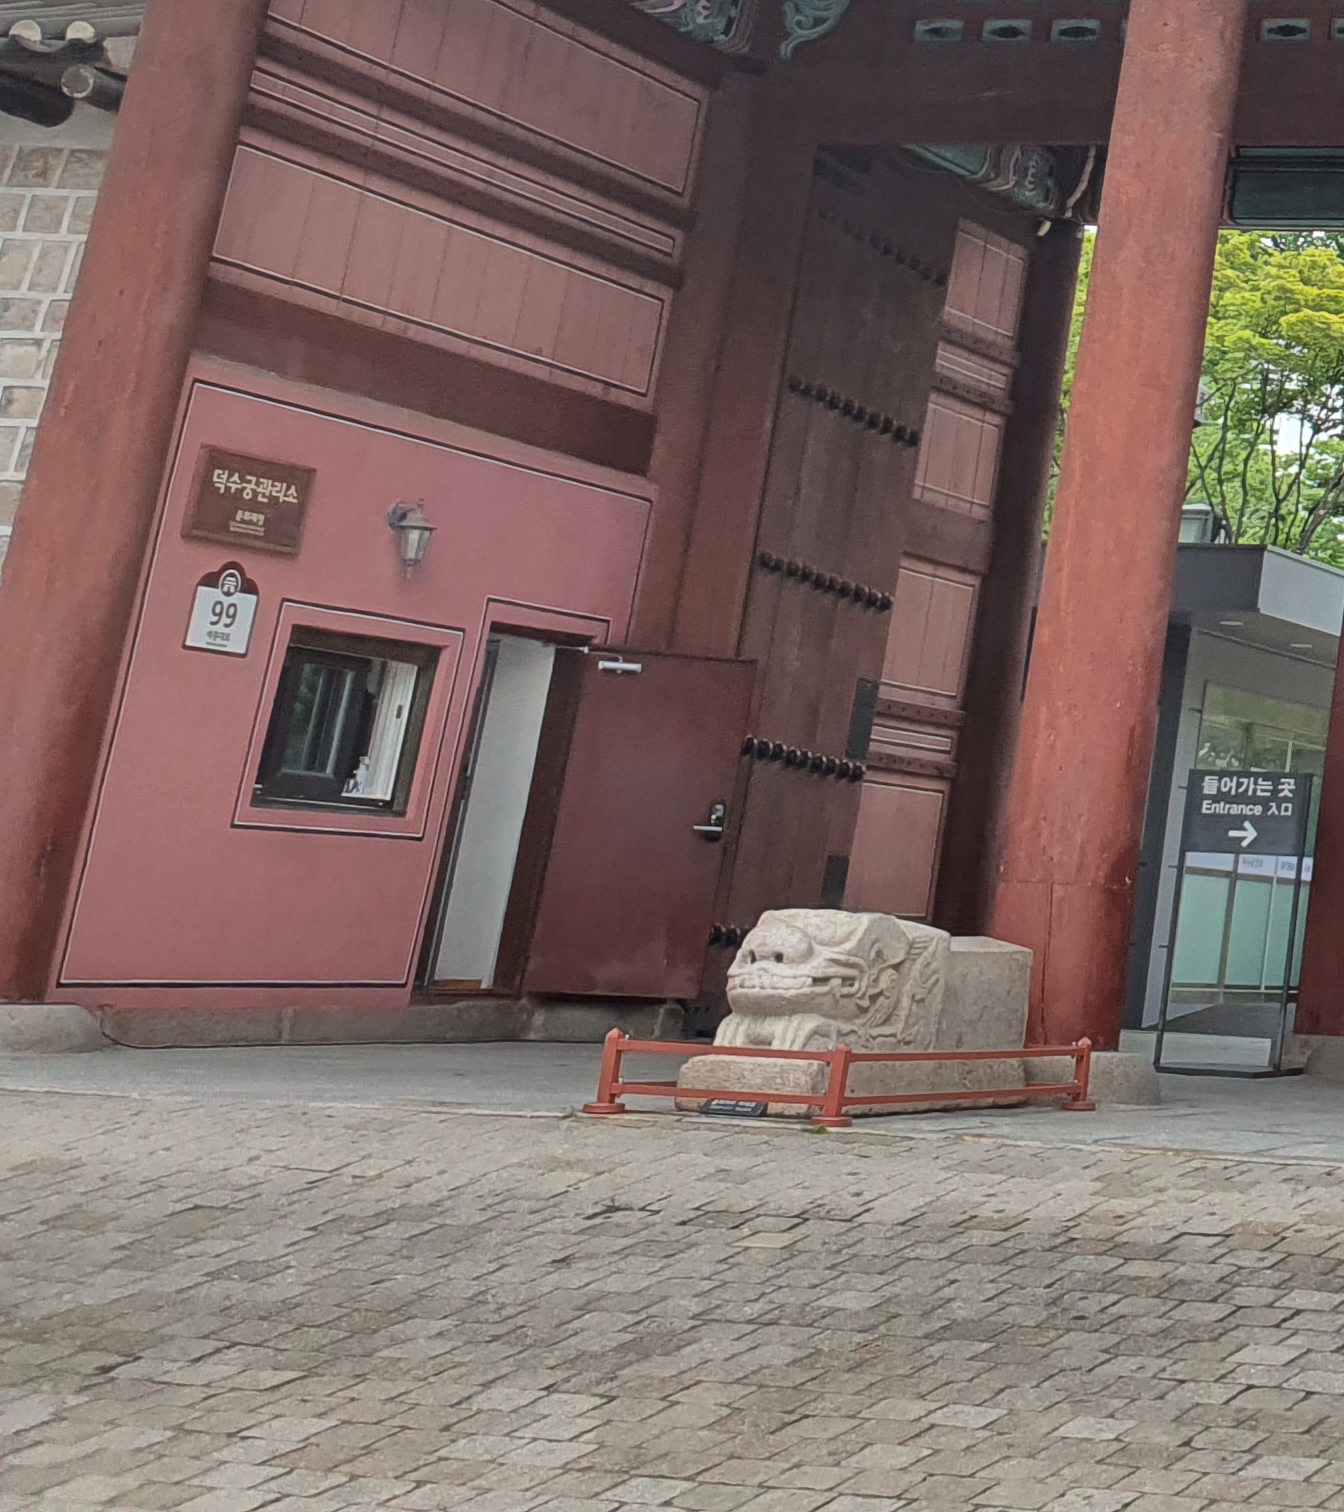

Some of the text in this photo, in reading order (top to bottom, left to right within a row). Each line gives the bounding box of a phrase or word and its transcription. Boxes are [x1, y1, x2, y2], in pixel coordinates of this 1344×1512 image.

[213, 469, 298, 503] 덕수궁관리소
[209, 600, 238, 628] 99
[1201, 775, 1296, 798] 들어가는 곳
[1201, 799, 1293, 816] Entrance 入口
